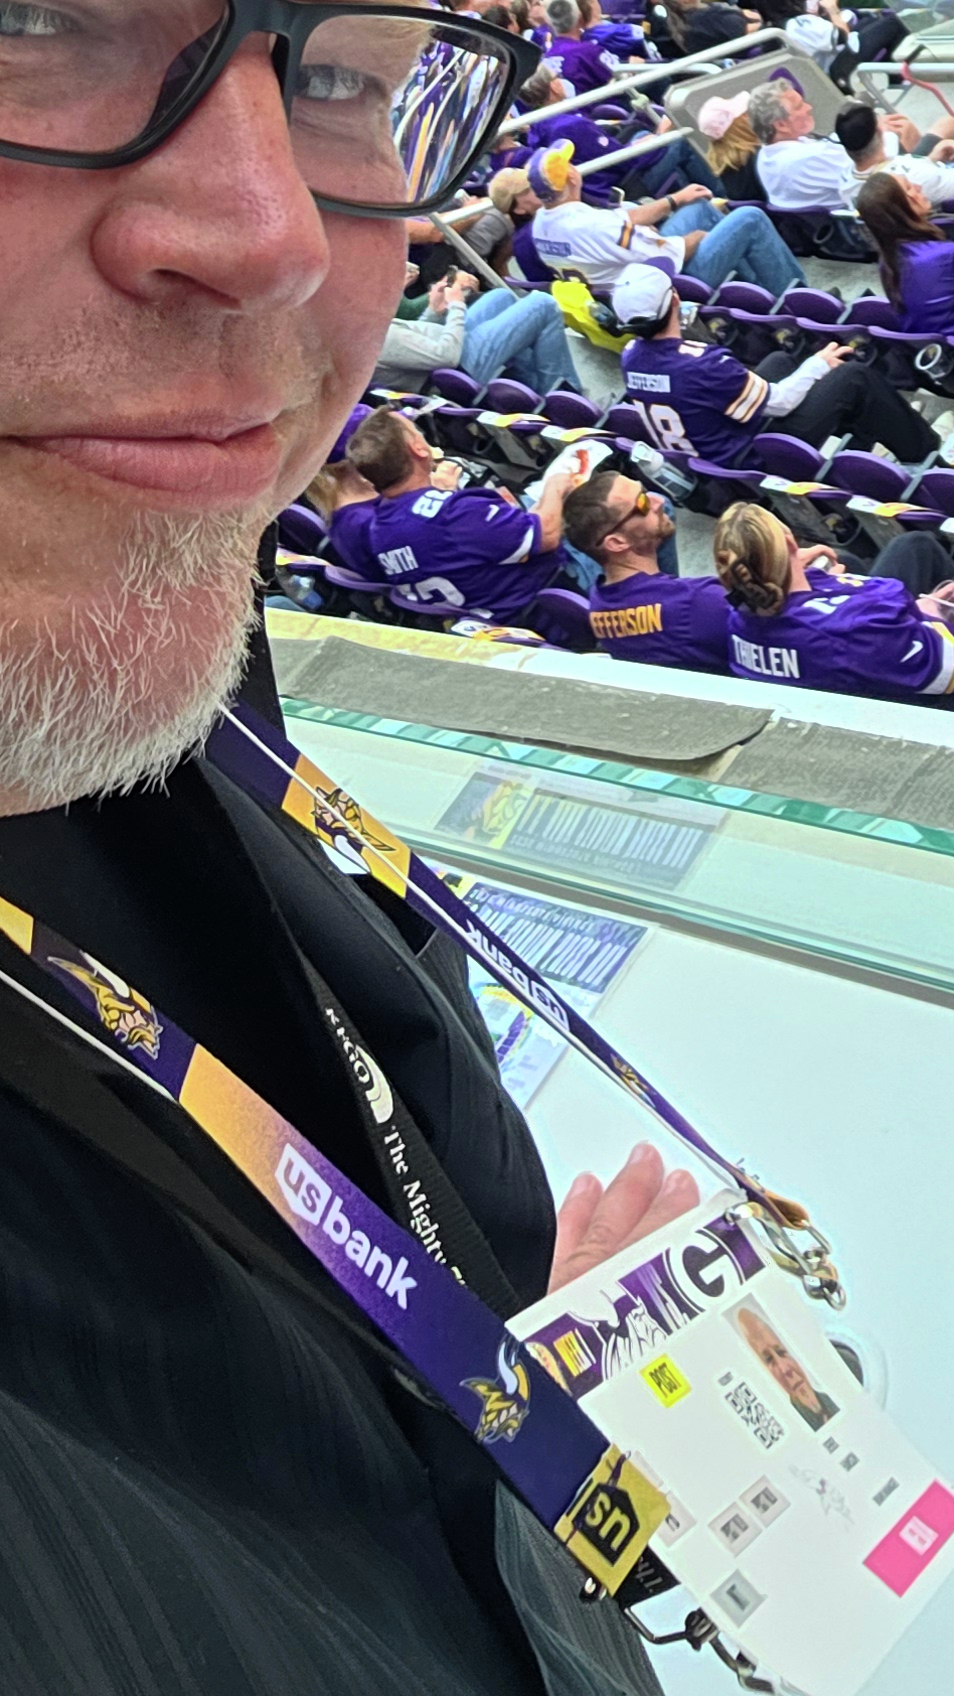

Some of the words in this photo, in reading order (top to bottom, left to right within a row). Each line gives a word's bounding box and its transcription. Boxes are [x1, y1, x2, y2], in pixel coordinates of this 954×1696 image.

[590, 603, 663, 639] EFFERSON
[731, 633, 800, 679] THIELEN
[384, 1124, 409, 1175] The
